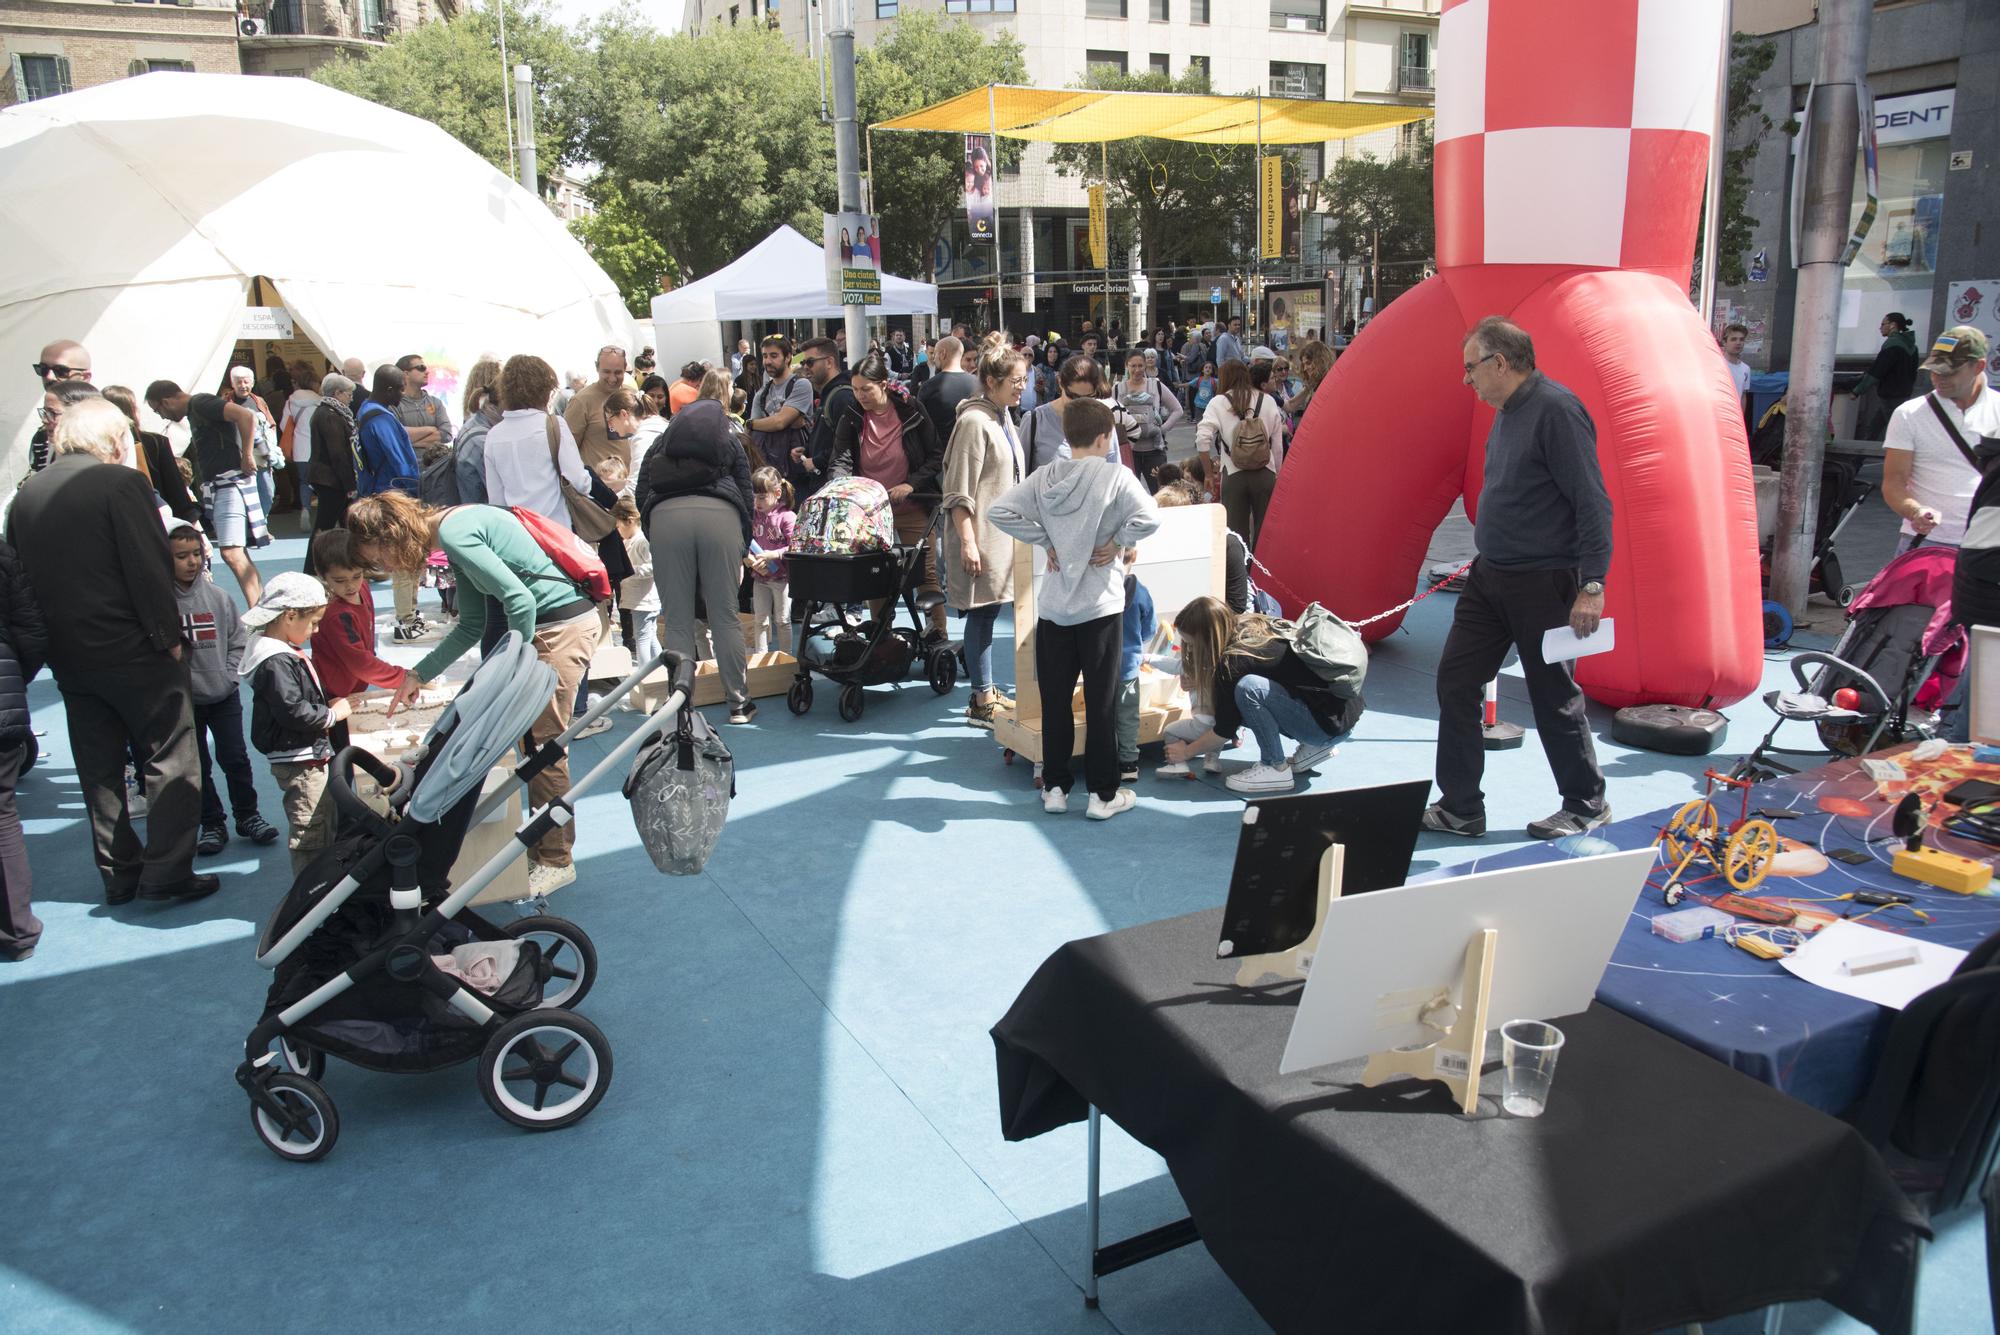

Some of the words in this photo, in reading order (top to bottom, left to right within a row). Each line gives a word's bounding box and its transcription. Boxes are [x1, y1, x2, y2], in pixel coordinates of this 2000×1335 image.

[1267, 161, 1275, 254] connectafibra.cat
[844, 270, 856, 278] Una
[857, 271, 875, 279] ciutat
[844, 281, 854, 289] per
[843, 293, 864, 303] VOTA
